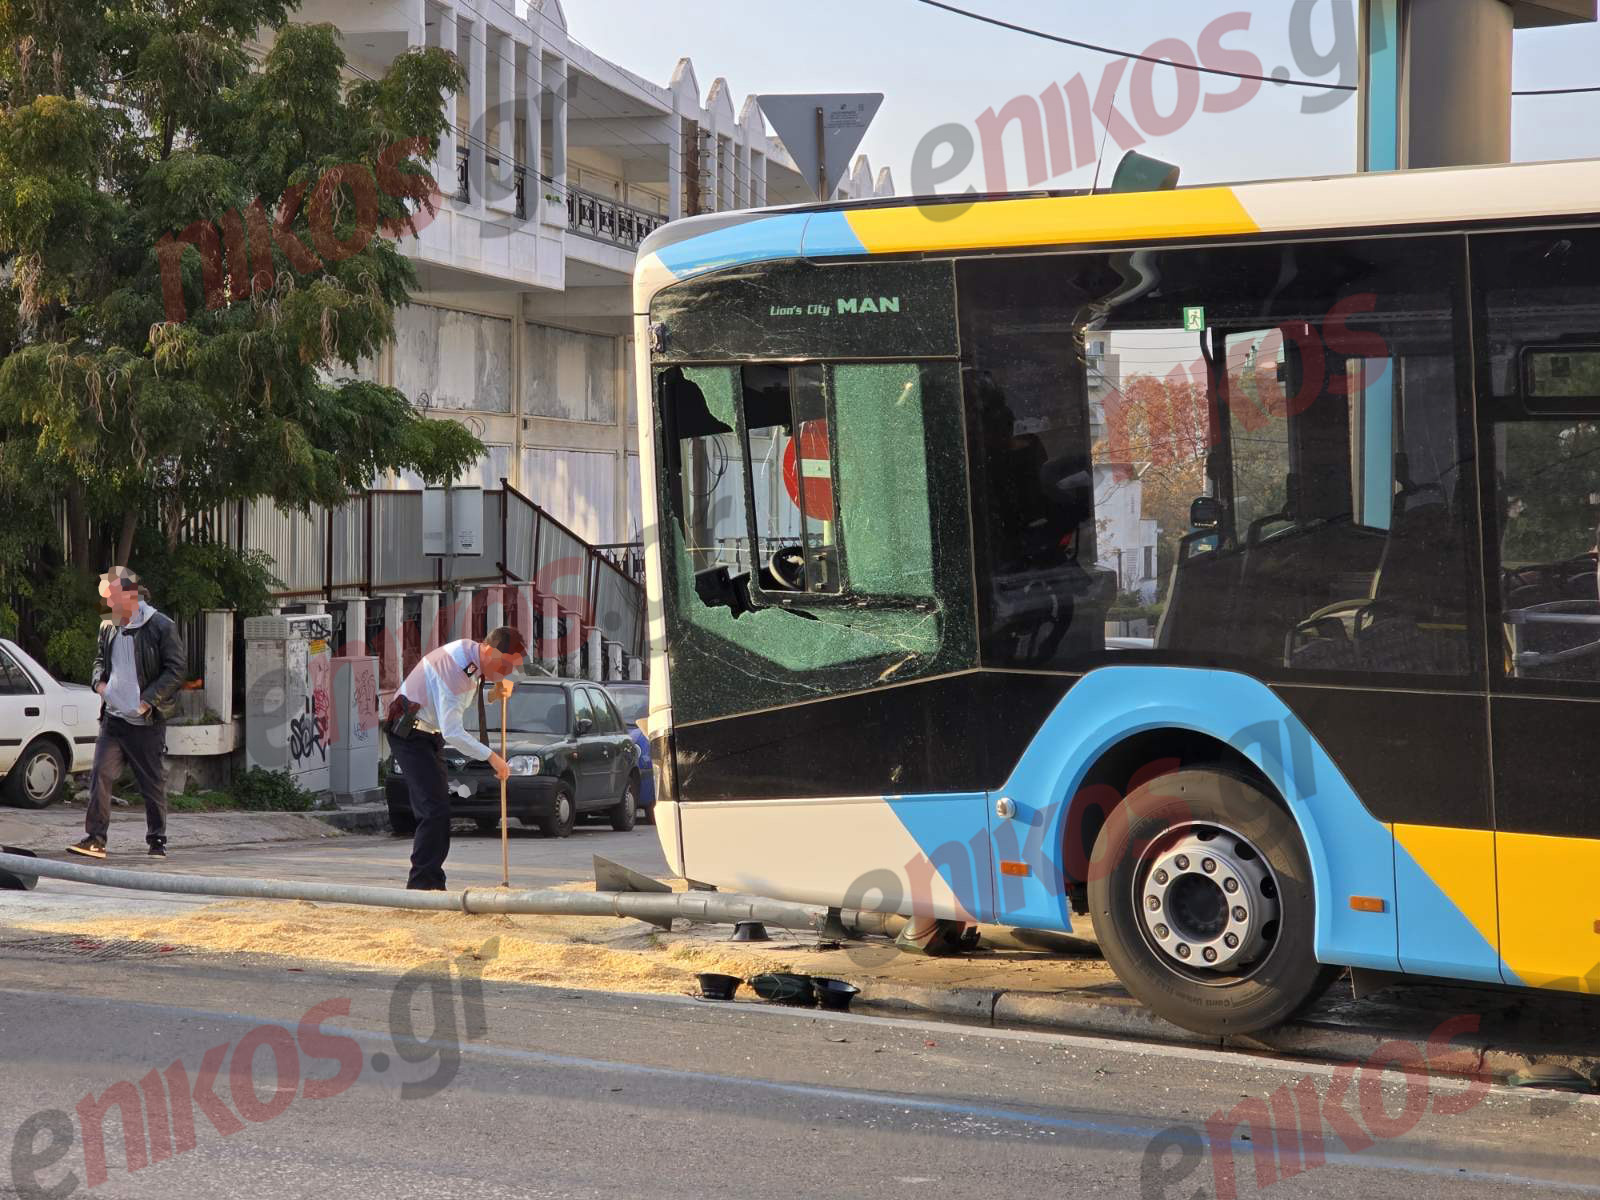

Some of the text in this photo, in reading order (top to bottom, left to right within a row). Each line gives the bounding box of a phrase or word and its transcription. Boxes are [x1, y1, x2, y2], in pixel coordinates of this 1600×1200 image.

[769, 297, 900, 316] Lion's City MAN
